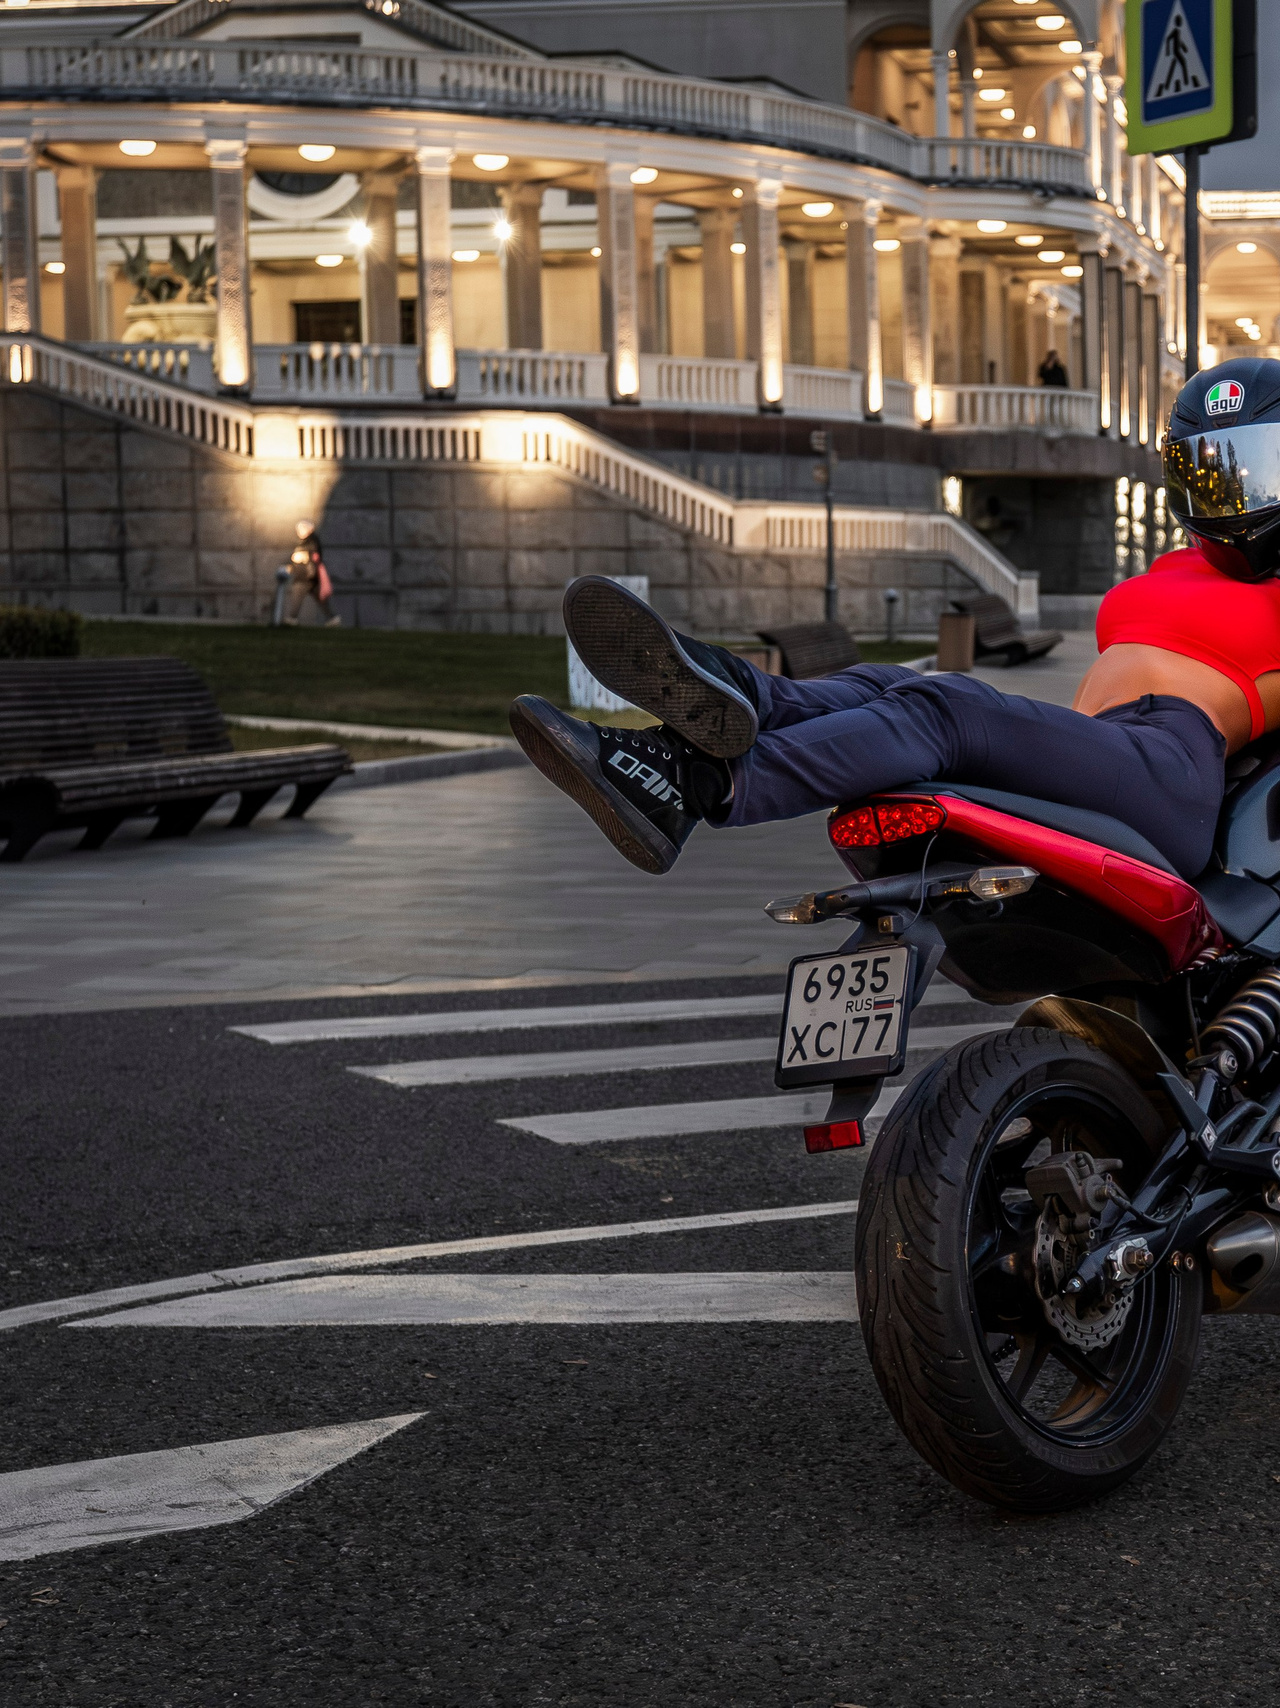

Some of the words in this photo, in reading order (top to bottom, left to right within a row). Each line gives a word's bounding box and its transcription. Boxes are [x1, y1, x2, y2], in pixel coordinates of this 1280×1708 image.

[803, 956, 891, 1003] 6935
[845, 998, 873, 1013] RUS
[852, 1012, 893, 1054] 77
